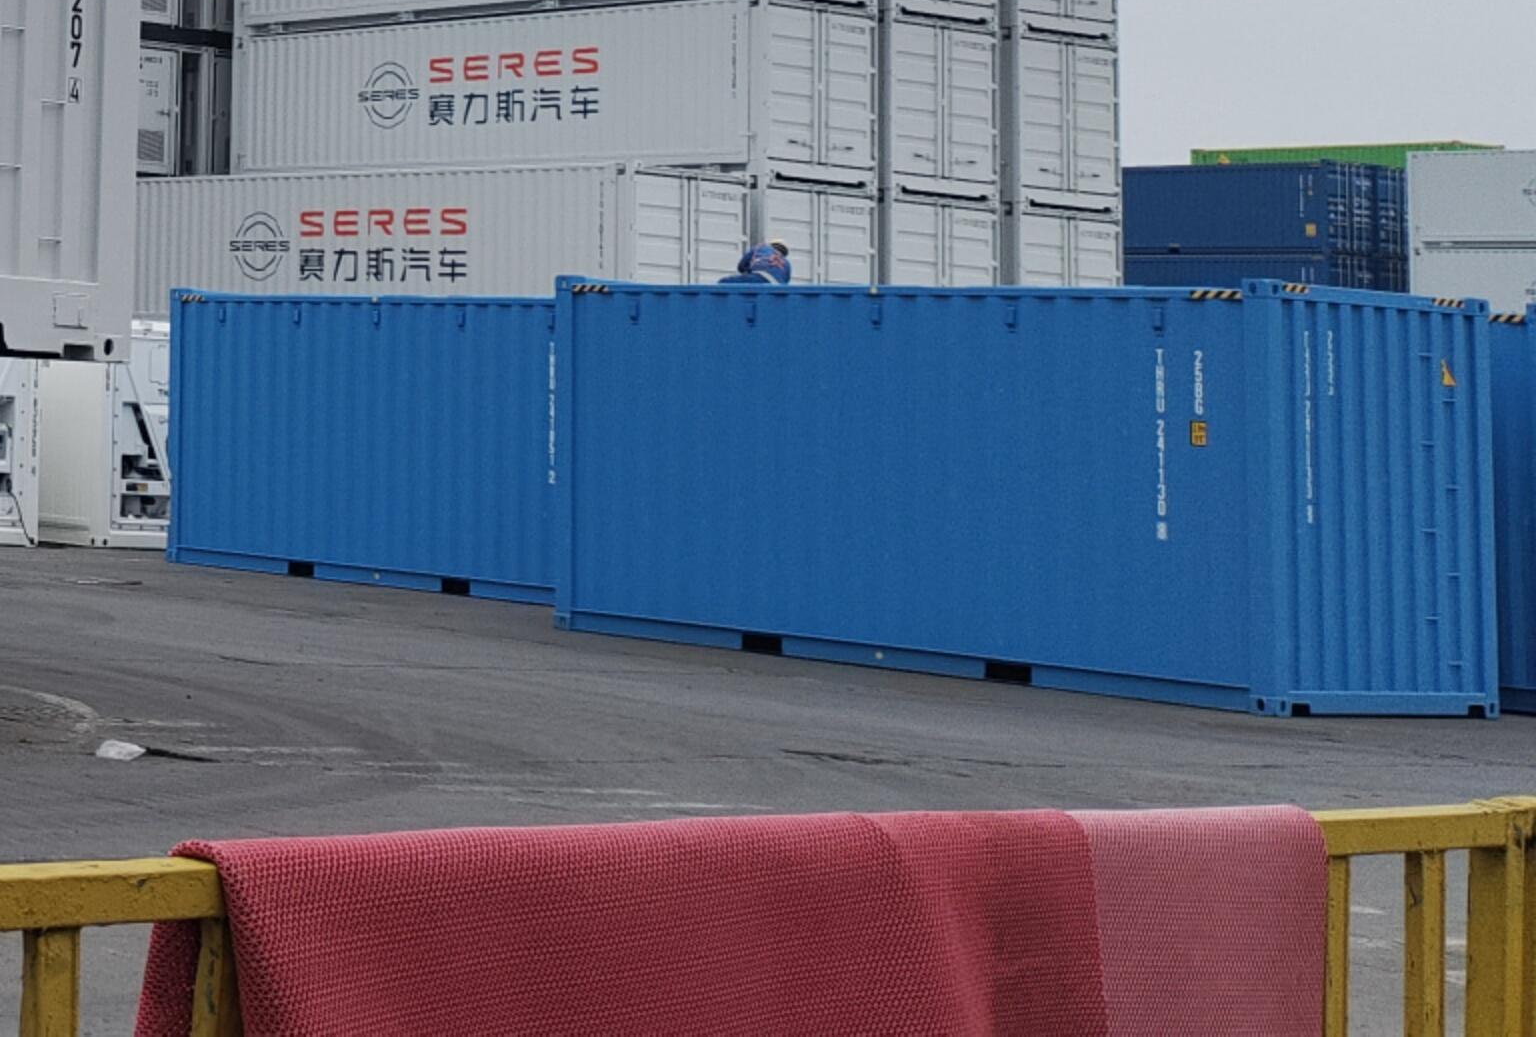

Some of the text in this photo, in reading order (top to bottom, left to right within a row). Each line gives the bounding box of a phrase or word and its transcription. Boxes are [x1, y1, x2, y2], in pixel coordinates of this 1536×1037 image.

[428, 47, 600, 83] SERES
[358, 88, 420, 103] SERES
[428, 85, 600, 126] 赛力斯汽车
[299, 208, 469, 238] SERES
[229, 240, 290, 252] SERES
[299, 247, 469, 283] 赛力斯汽车
